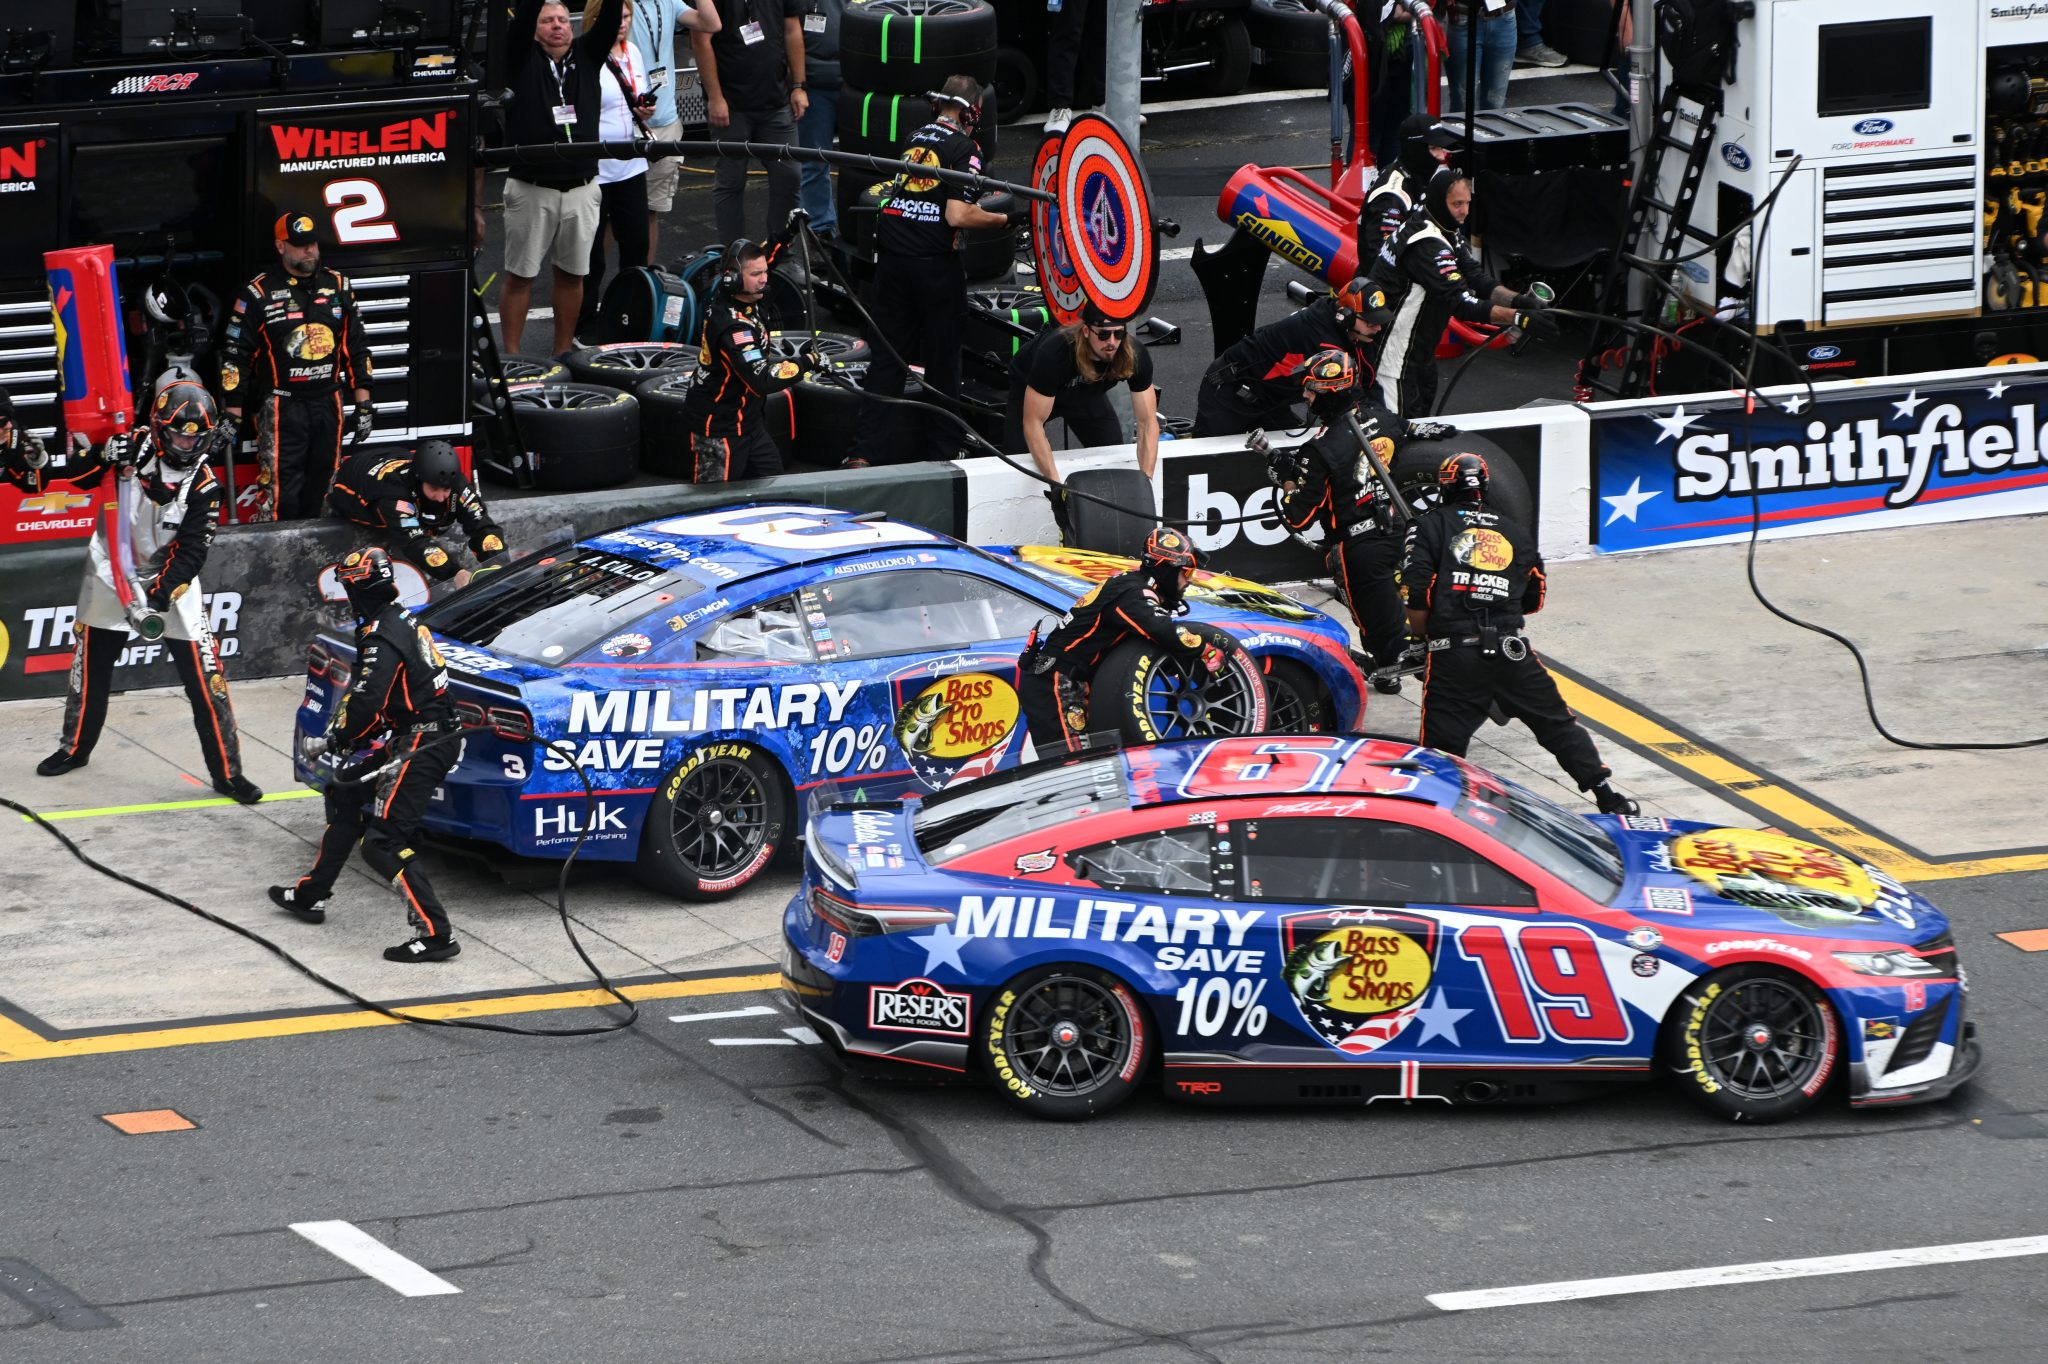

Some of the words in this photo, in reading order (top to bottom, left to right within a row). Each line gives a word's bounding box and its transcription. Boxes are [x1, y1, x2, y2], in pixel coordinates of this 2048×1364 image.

[143, 73, 199, 92] RCR
[413, 69, 456, 77] CHEVROLET
[271, 112, 447, 160] WHELEN
[1854, 138, 1915, 149] PERFORMANCE
[280, 157, 376, 173] MANUFACTURED
[378, 155, 391, 167] IN
[393, 152, 446, 166] AMERICA
[323, 178, 401, 245] 2
[886, 198, 940, 214] RACKER
[918, 214, 940, 222] ROAD
[1242, 215, 1320, 270] SUNOCO
[289, 364, 333, 377] TRACKER
[1464, 476, 1479, 487] 3
[16, 518, 95, 532] CHEVROLET
[1477, 530, 1502, 544] Bass
[600, 531, 740, 579] BassPro.com
[1479, 542, 1498, 553] Pro
[1479, 552, 1507, 568] Shops
[380, 567, 391, 578] 3
[1452, 571, 1510, 591] TRACKER
[683, 598, 730, 623] BETMGM
[1241, 657, 1261, 689] HONOR
[945, 678, 993, 702] Bass
[569, 680, 863, 733] MILITARY
[945, 701, 983, 724] Pro
[945, 719, 1006, 747] Shops
[543, 738, 664, 771] SAVE
[810, 724, 886, 775] 10%
[502, 754, 527, 779] 3
[666, 744, 752, 800] GOODYEAR
[536, 834, 593, 846] Performace
[595, 833, 628, 841] Fishing
[700, 879, 737, 891] REMEMBER
[954, 896, 1266, 946] MILITARY
[824, 932, 847, 963] 19
[1344, 929, 1400, 955] Bass
[1704, 939, 1813, 961] GOODYEAR
[1154, 947, 1266, 973] SAVE
[1346, 954, 1389, 977] Pro
[1344, 976, 1414, 1007] Shops
[1454, 922, 1635, 1045] 19
[877, 993, 964, 1027] RESER'S
[1176, 977, 1269, 1037] 10%
[916, 1019, 942, 1027] FOODS
[988, 990, 1032, 1099] GOODYEAR
[1684, 983, 1723, 1093] GOODYEAR
[1177, 1082, 1223, 1095] TRD
